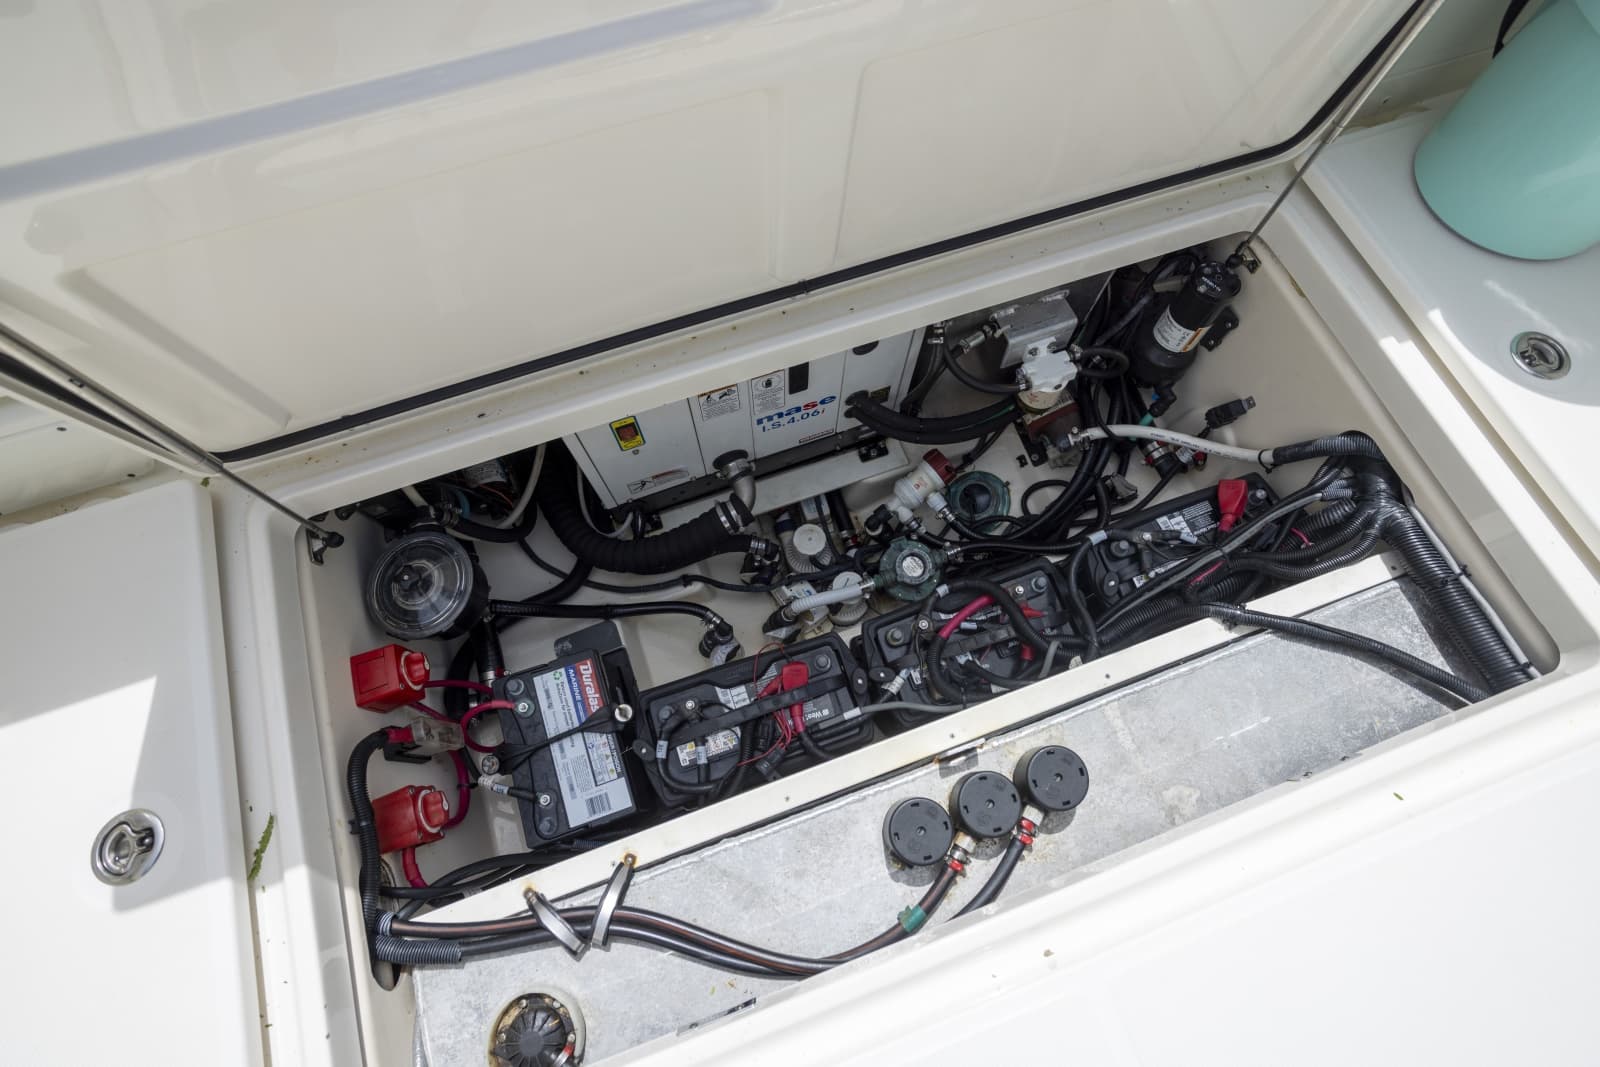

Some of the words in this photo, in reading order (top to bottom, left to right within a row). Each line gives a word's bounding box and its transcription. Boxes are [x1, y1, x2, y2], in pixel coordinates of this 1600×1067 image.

[756, 396, 836, 425] mase
[568, 669, 583, 701] MARINE
[580, 660, 600, 712] Duralas
